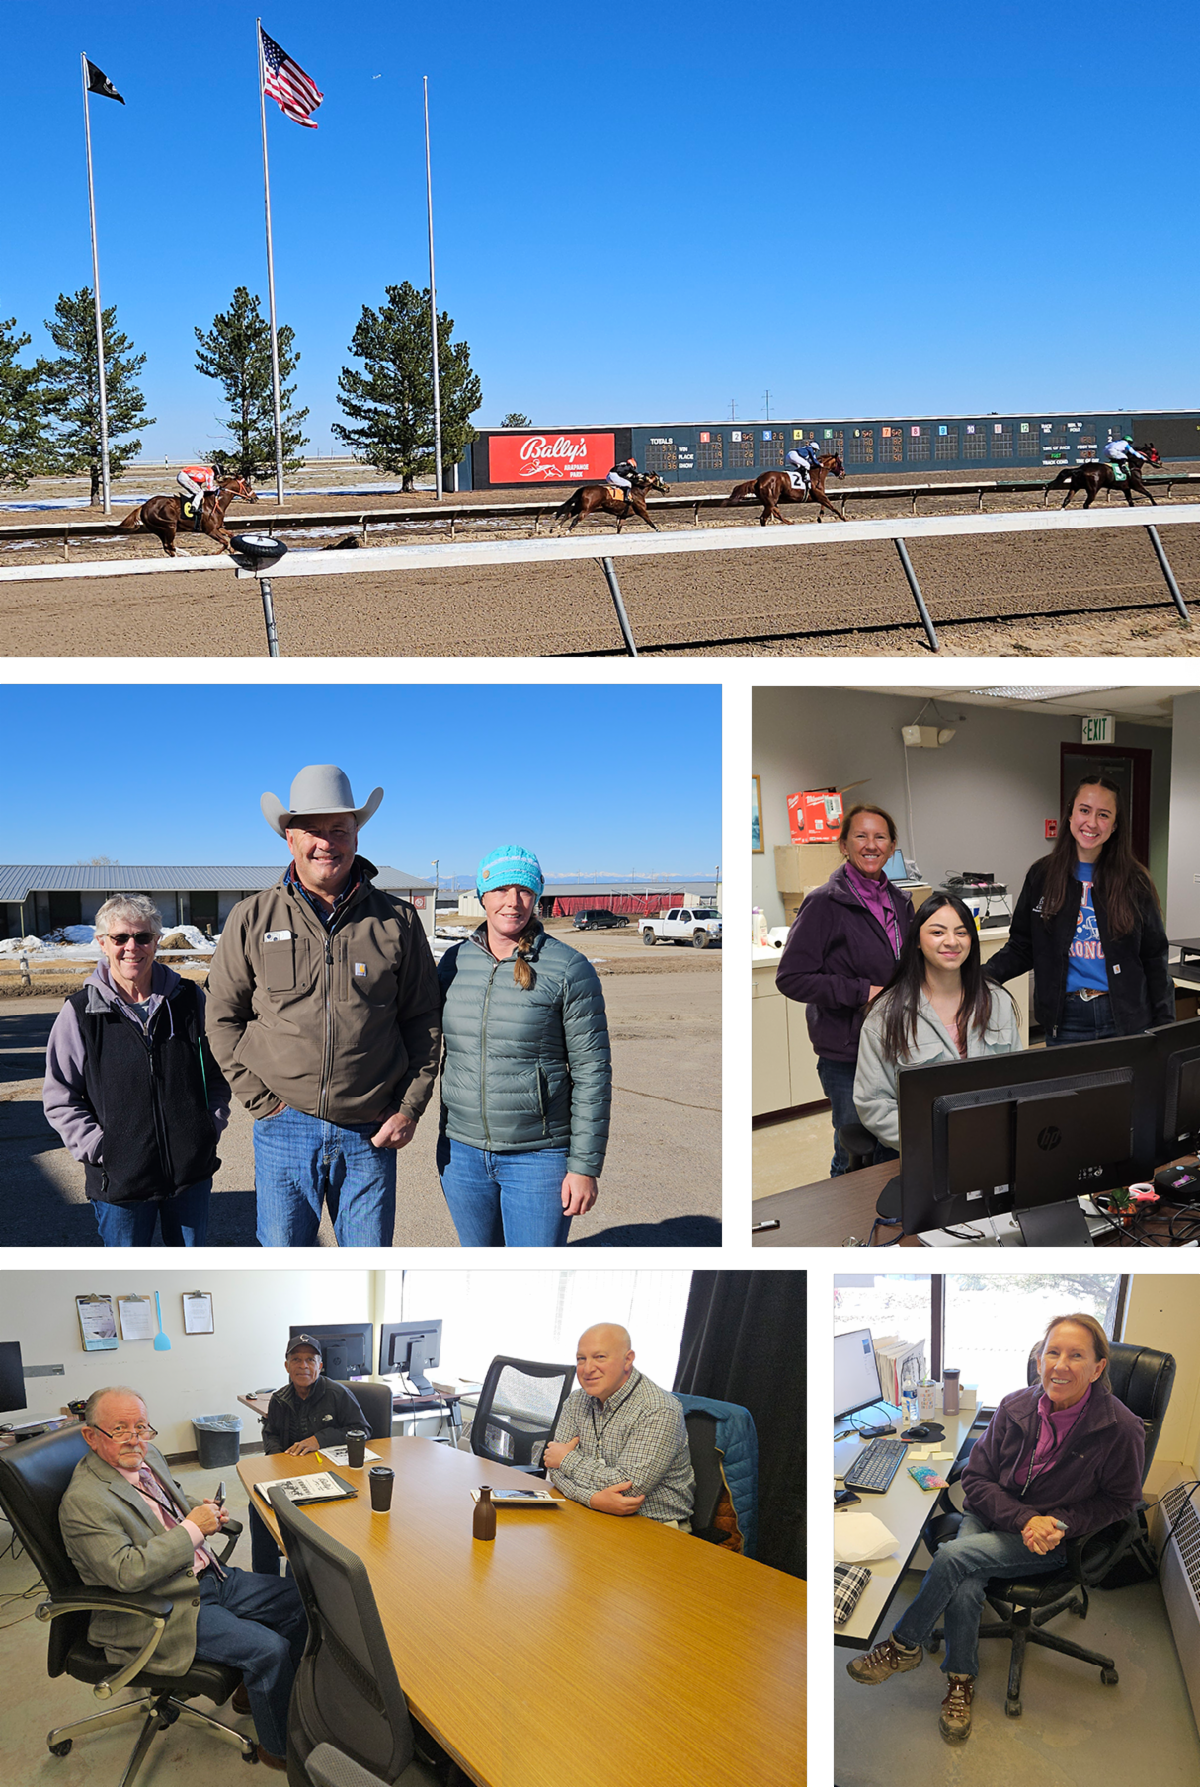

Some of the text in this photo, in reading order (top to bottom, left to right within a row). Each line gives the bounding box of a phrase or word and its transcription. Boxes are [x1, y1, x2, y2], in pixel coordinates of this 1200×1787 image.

[967, 425, 975, 433] 10
[1021, 424, 1029, 432] 12
[520, 436, 587, 463] Bally's
[792, 474, 801, 486] 2
[1087, 718, 1107, 741] EXIT
[1038, 1126, 1061, 1151] hp
